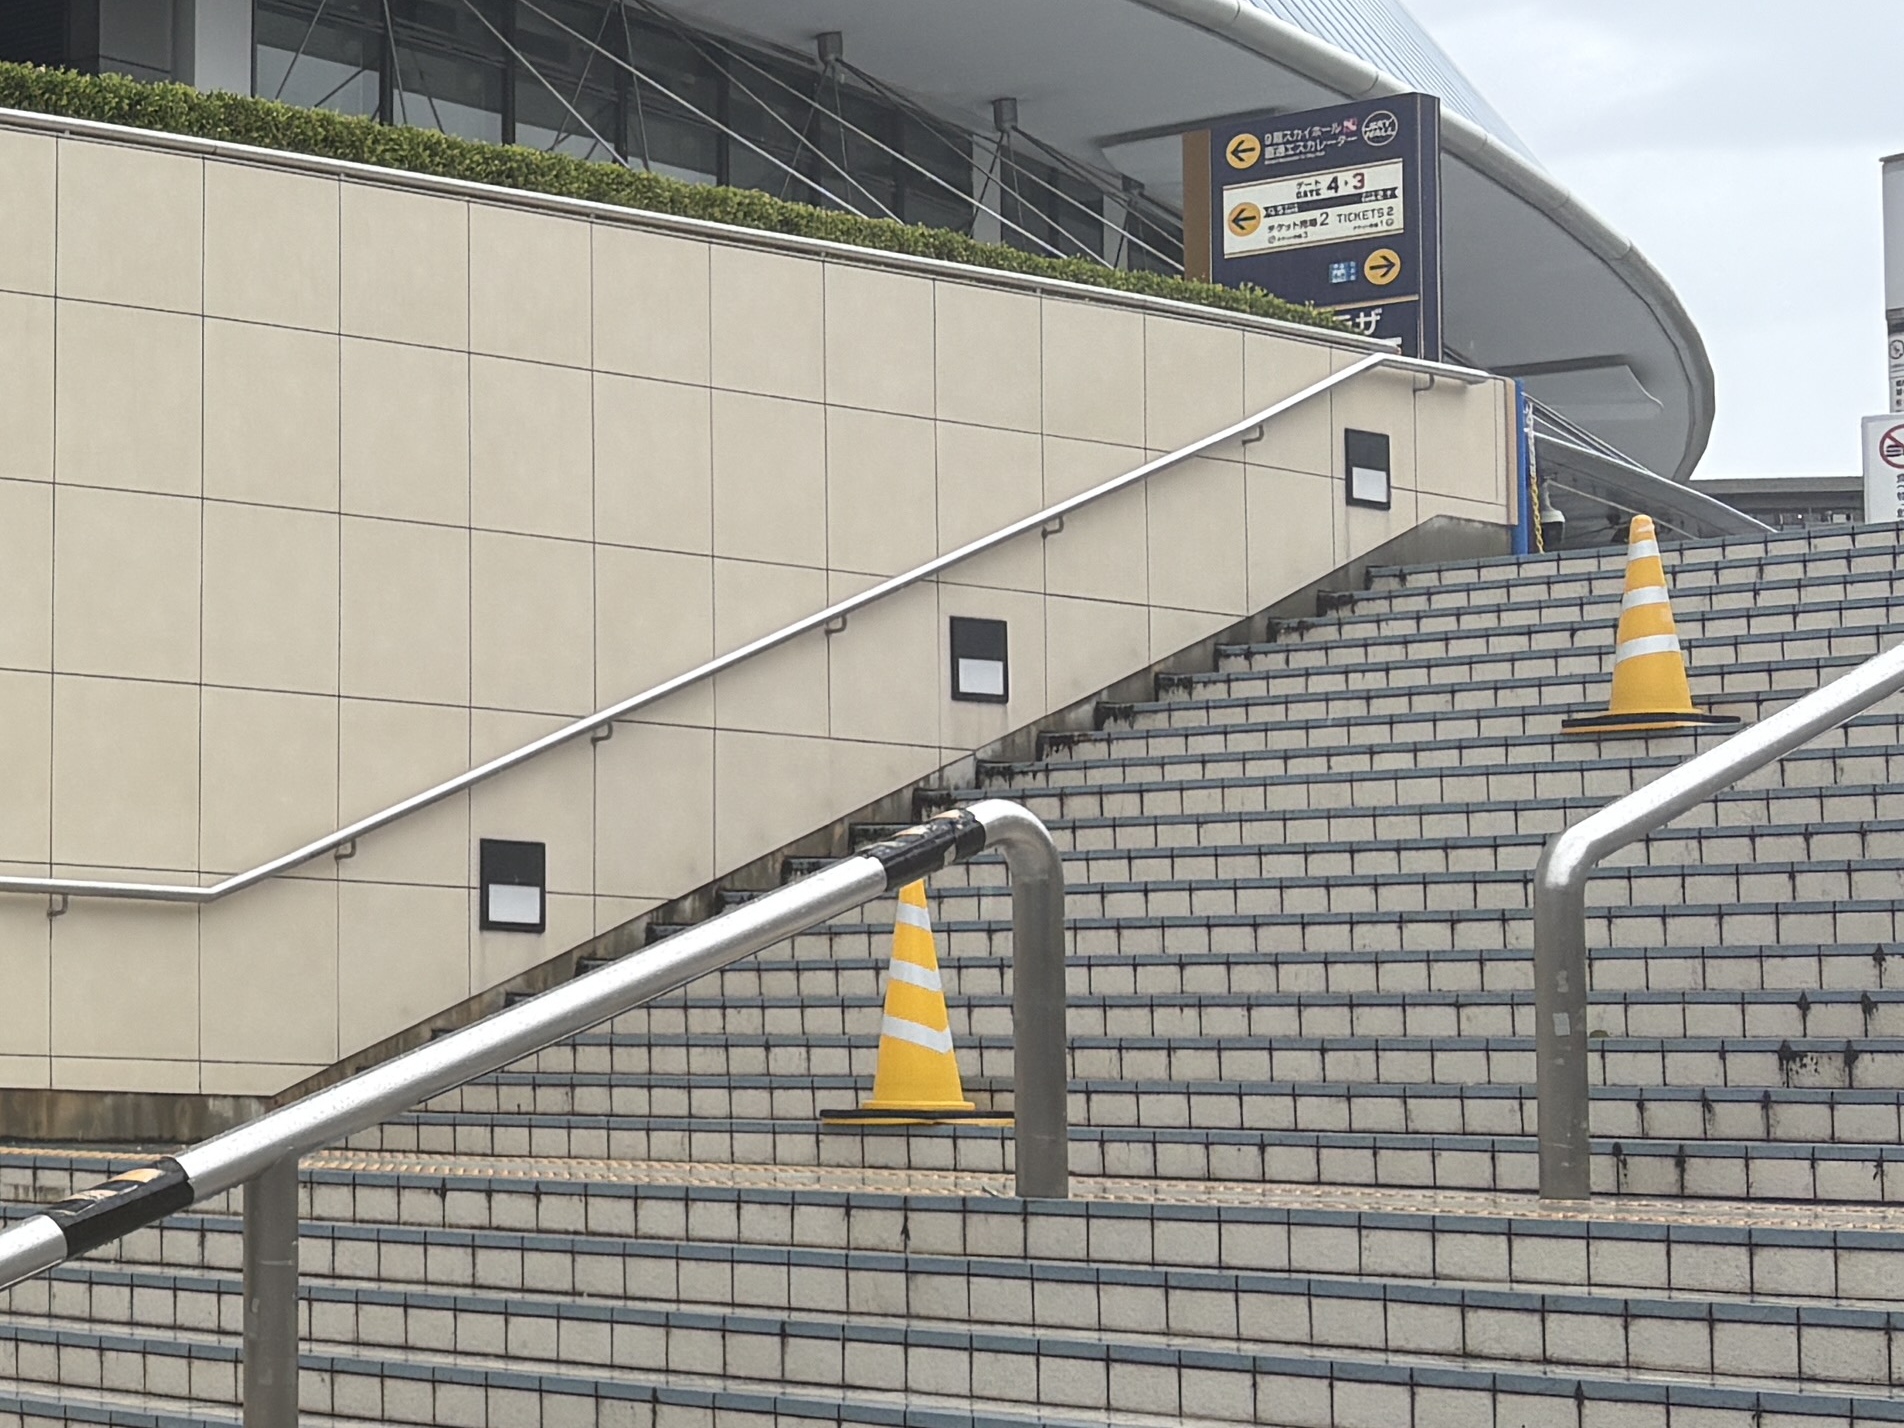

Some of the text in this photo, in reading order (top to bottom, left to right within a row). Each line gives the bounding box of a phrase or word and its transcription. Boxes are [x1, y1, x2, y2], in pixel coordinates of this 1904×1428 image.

[1326, 175, 1340, 194] 4
[1352, 172, 1366, 190] 3
[1336, 208, 1384, 224] TICKETS
